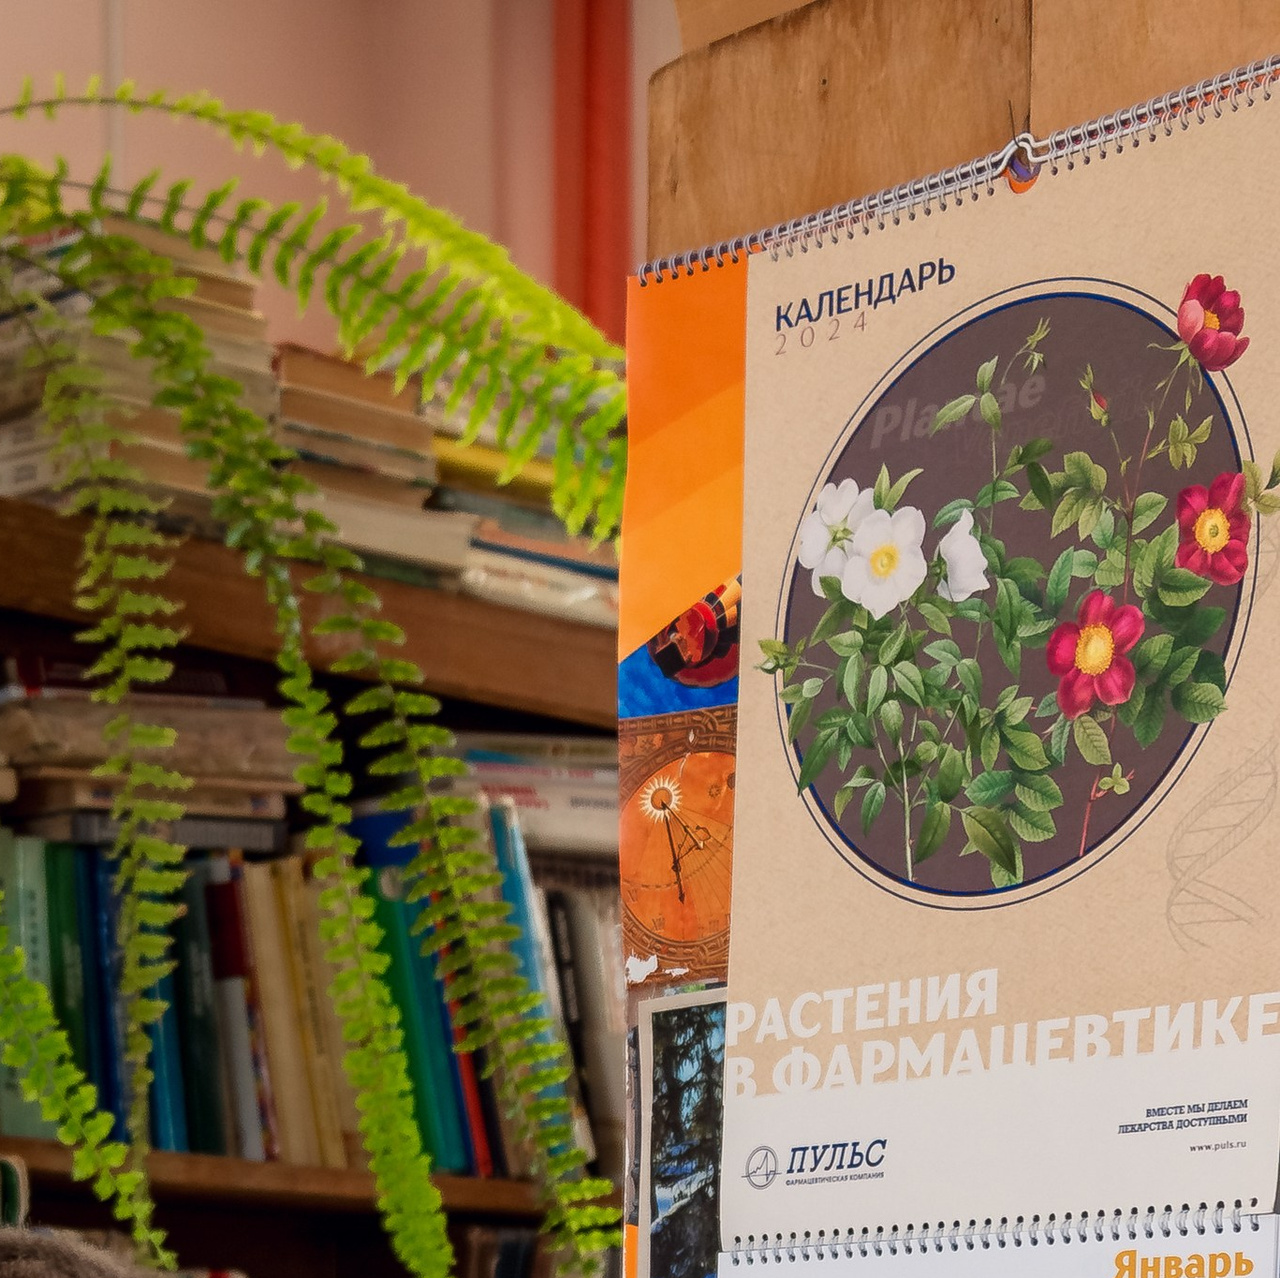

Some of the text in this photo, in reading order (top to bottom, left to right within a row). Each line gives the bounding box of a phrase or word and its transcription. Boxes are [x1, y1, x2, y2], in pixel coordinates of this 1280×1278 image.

[776, 257, 956, 332] КАЛЕНДАРЬ
[775, 313, 869, 357] 2024
[871, 375, 1047, 449] Plaae
[727, 968, 999, 1047] РАСТЕНИЯ
[727, 991, 1280, 1099] В ФАРМАЦЕВТИКЕ
[1118, 1113, 1248, 1134] ЛЕКАРСТВА ДОСТУПНЫМИ
[1146, 1099, 1248, 1118] ВМЕСТЕ МЫ ДЕЛАЕМ
[786, 1138, 888, 1174] ПУЛЬС
[1189, 1140, 1248, 1152] www.puls.ru
[785, 1171, 885, 1186] ФАРМАЦЕВТИЧЕСКАЯ КОМПАНИЯ
